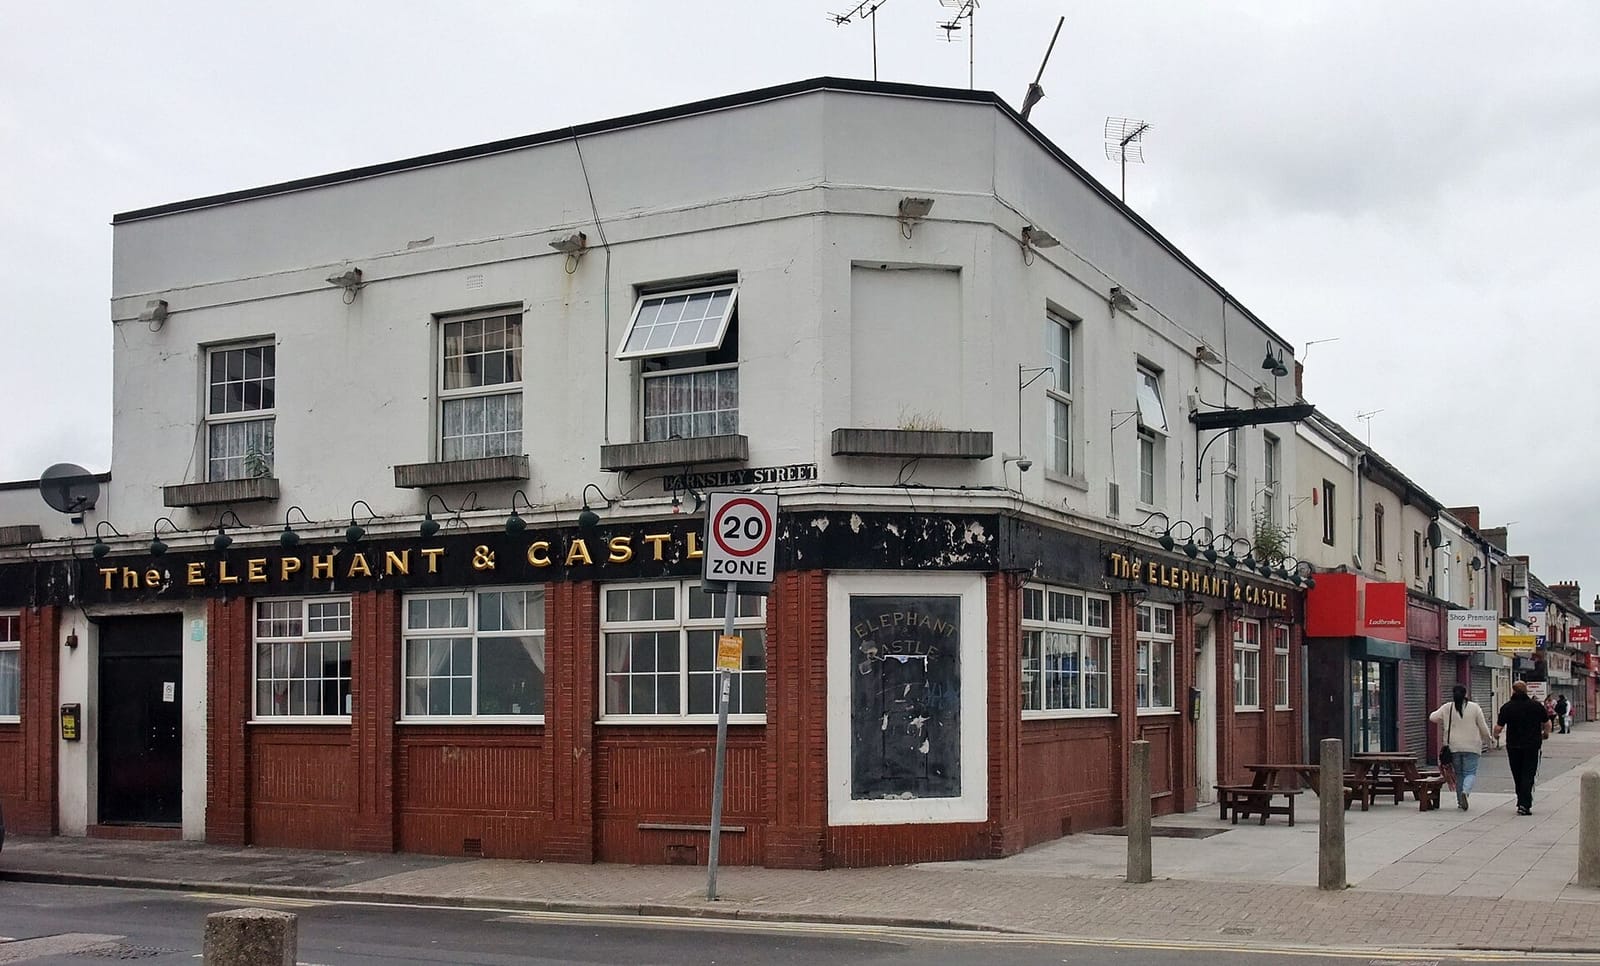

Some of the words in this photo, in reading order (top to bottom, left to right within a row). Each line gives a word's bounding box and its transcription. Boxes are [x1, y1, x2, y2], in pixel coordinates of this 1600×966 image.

[665, 470, 747, 490] BARNSLEY
[754, 465, 817, 483] STREET
[723, 516, 763, 540] 20
[100, 567, 160, 590] The
[187, 547, 445, 585] ELEPHANT
[472, 544, 496, 571] &
[527, 532, 704, 567] CASTL
[713, 560, 767, 575] ZONE
[1111, 553, 1141, 579] The
[1149, 562, 1229, 598] ELEPHANT
[1233, 581, 1241, 601] &
[1245, 585, 1287, 610] CASTLE
[855, 612, 956, 638] ELEPHANT
[1450, 613, 1465, 622] Shop
[1467, 613, 1496, 621] Premises
[864, 640, 939, 661] ASTLE
